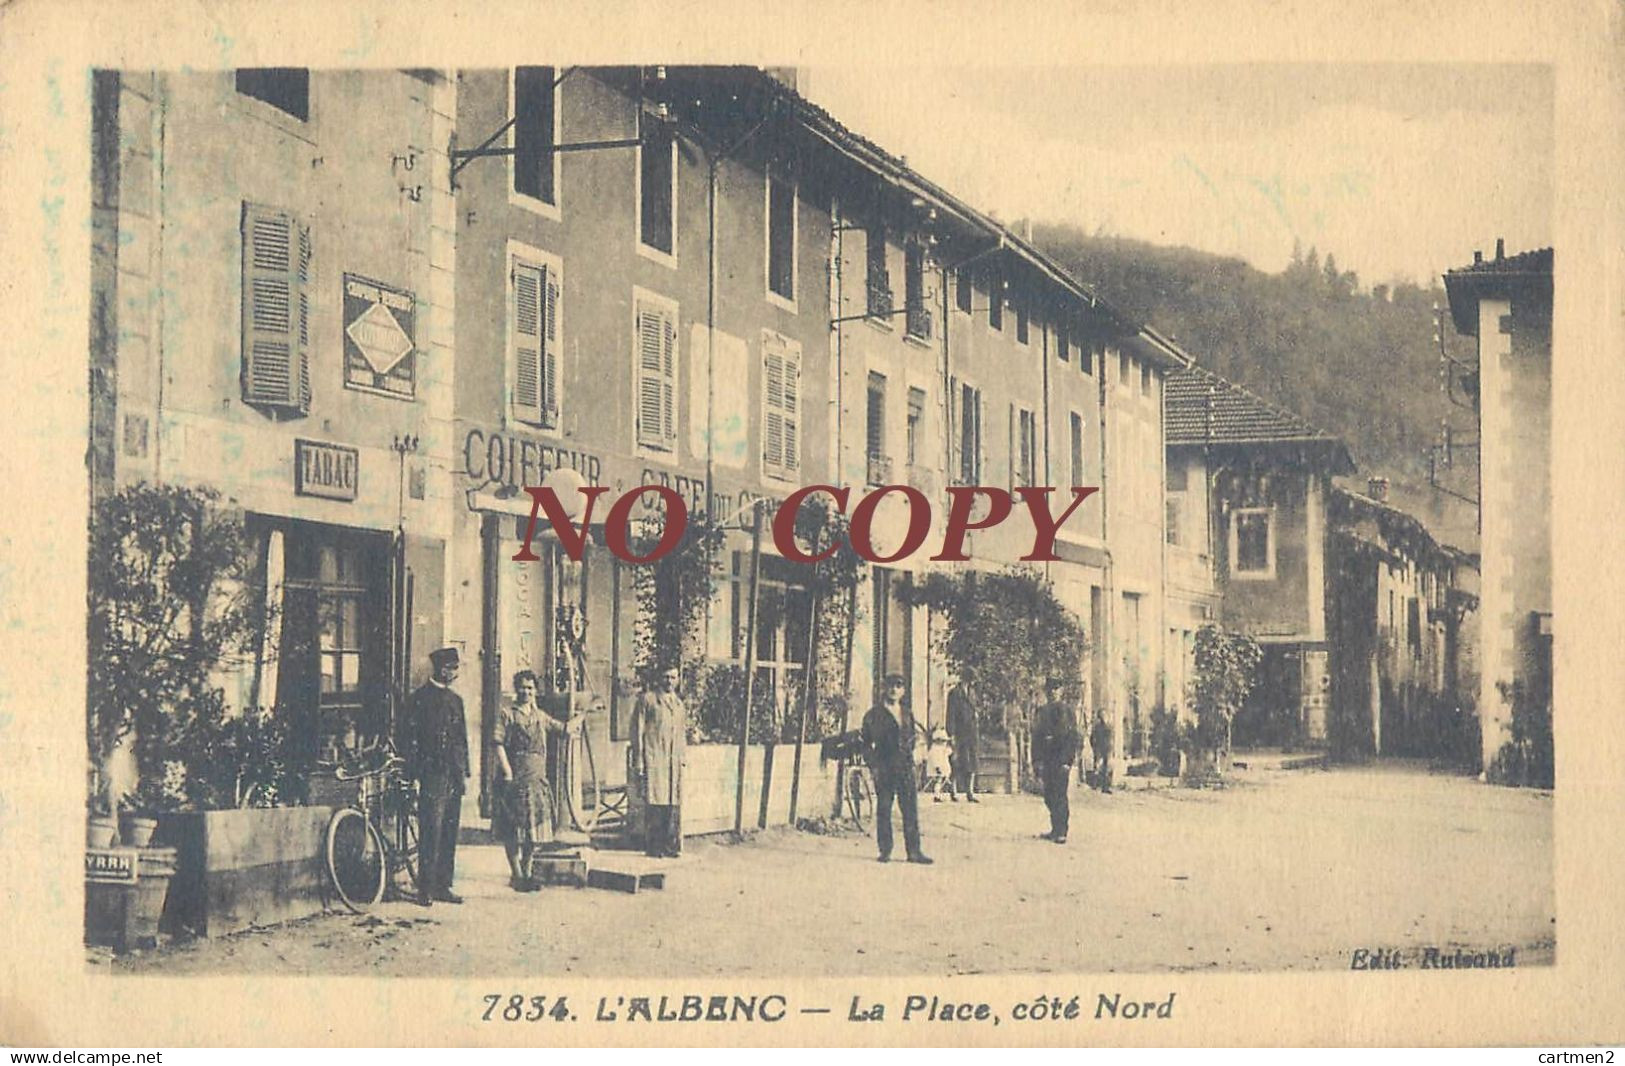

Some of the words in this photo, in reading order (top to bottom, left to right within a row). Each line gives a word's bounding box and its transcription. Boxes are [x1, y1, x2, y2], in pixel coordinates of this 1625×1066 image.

[302, 448, 353, 489] TABAC
[481, 994, 577, 1022] 7834.
[596, 995, 787, 1022] L'ALBENC
[848, 995, 885, 1022] La
[902, 995, 1001, 1026] Place,
[1012, 994, 1080, 1021] côté
[1094, 992, 1176, 1020] Nord
